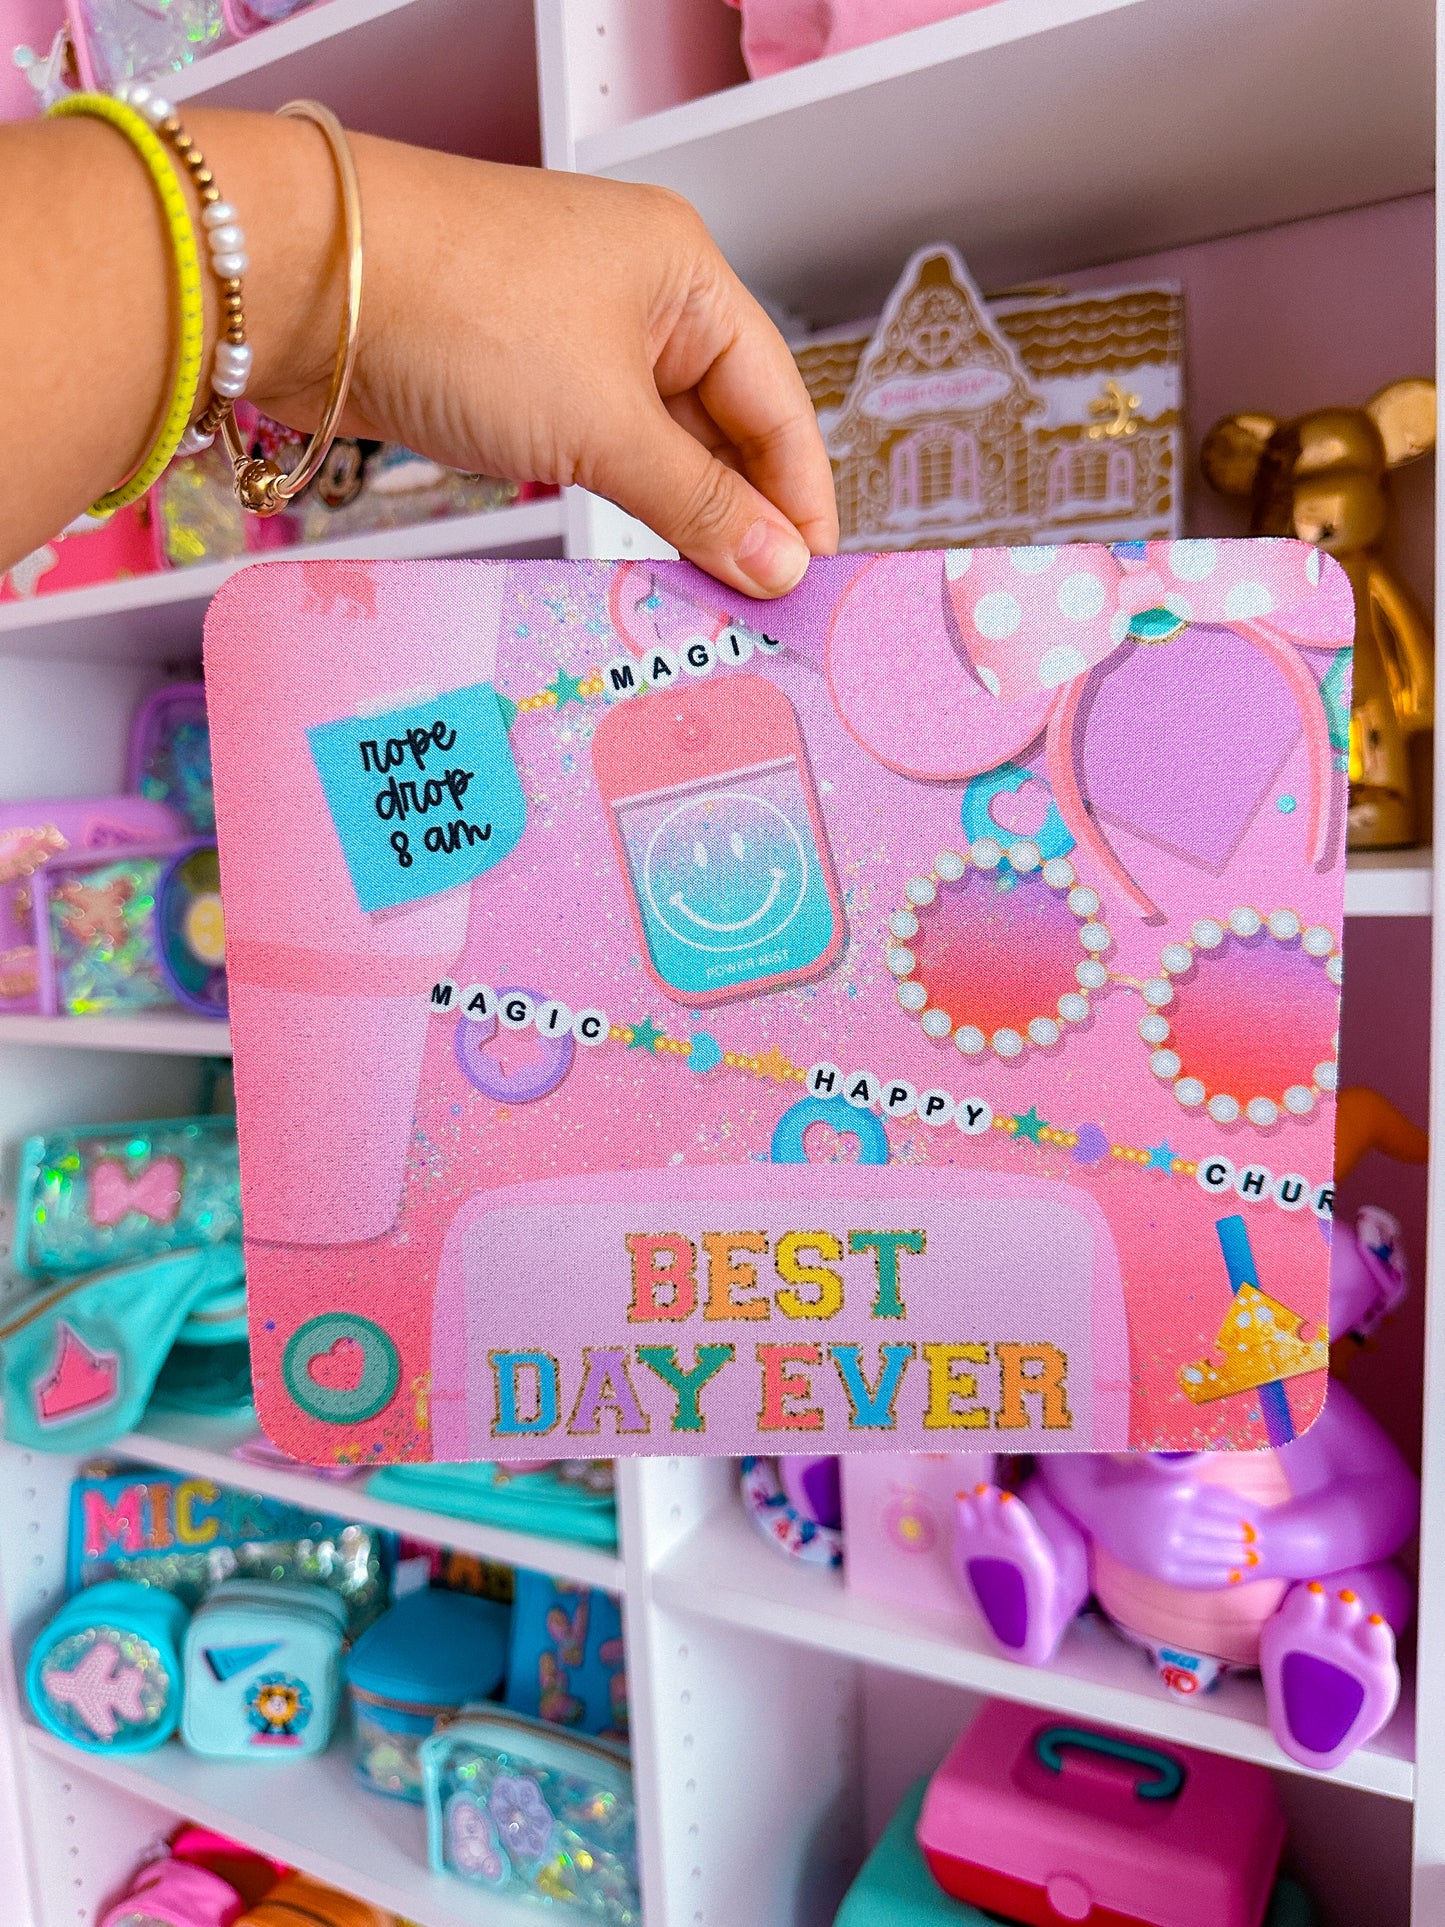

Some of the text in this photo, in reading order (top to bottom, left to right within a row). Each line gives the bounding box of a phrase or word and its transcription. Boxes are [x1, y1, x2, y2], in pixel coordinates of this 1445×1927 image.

[359, 720, 457, 774] rope
[375, 768, 475, 821] drop
[390, 819, 492, 868] 8 am
[705, 957, 755, 980] POWER
[431, 983, 601, 1038] MAGIC
[814, 1068, 984, 1127] HAPPY
[625, 1229, 927, 1324] BEST
[487, 1340, 1073, 1437] DAY EVER
